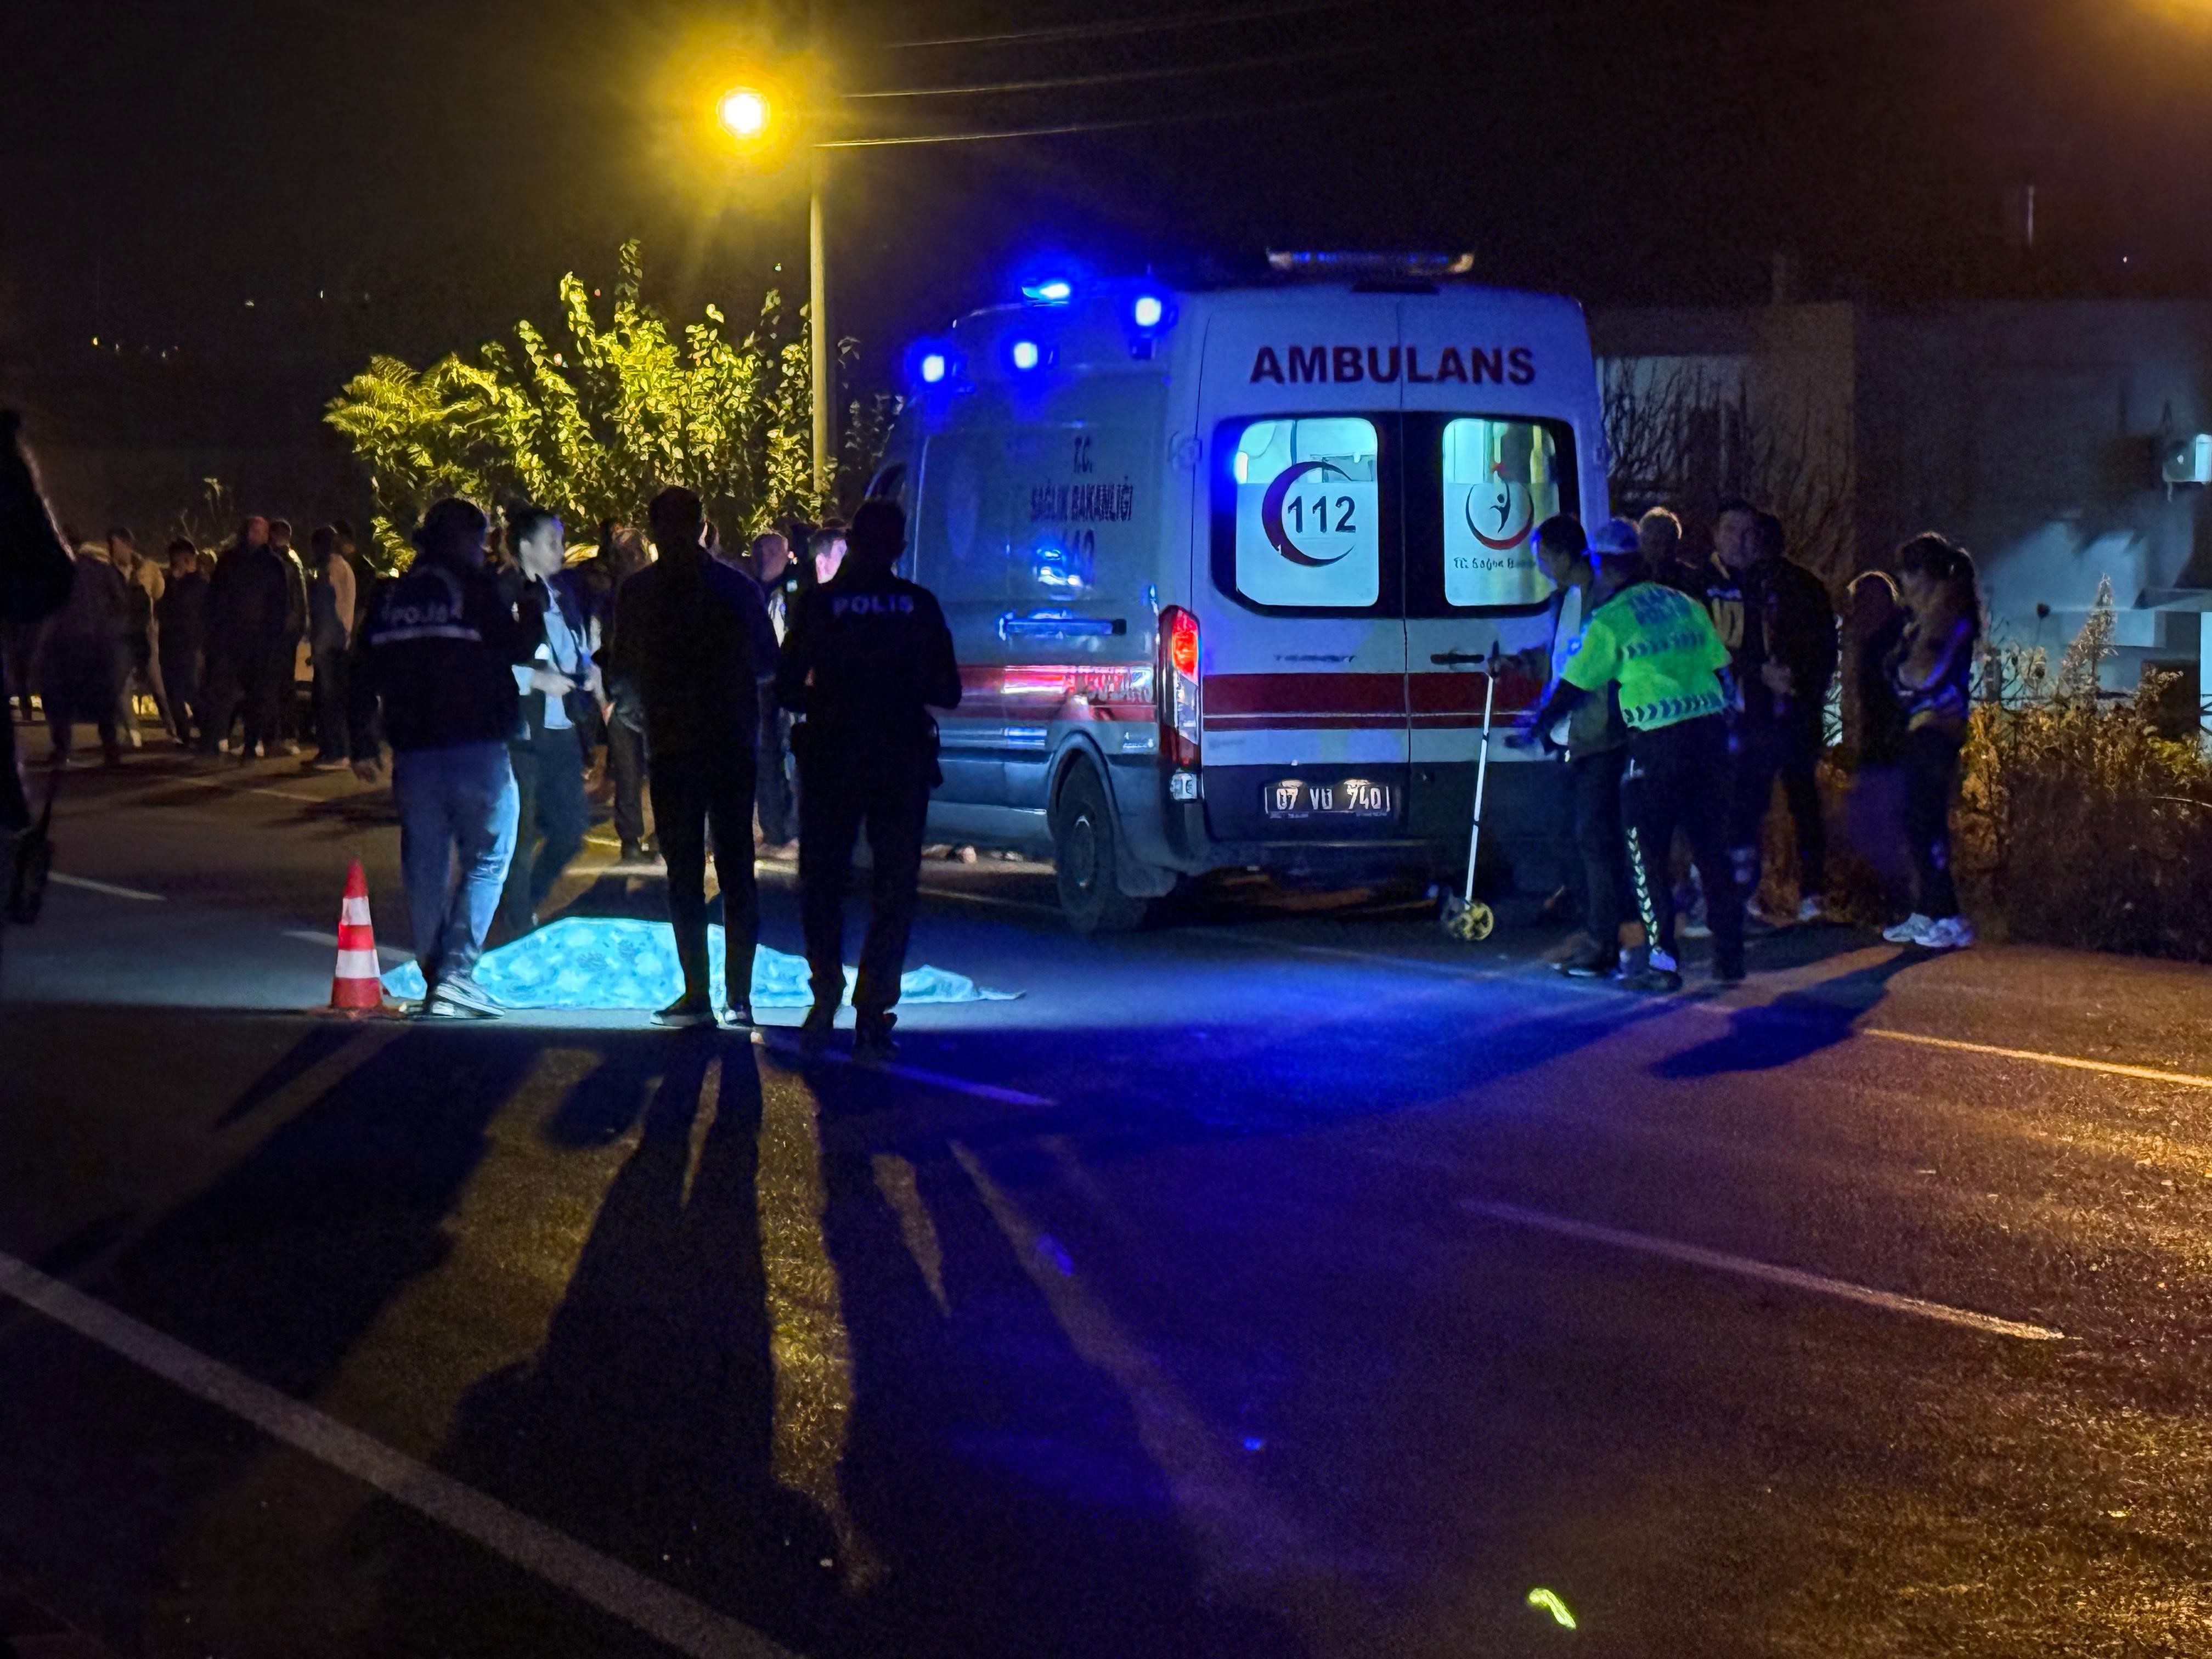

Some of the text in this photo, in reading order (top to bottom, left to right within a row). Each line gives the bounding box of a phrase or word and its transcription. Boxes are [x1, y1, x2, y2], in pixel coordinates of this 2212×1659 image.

[1250, 345, 1536, 385] AMBULANS
[1288, 495, 1356, 533] 112
[1276, 788, 1299, 810] 07
[1347, 785, 1381, 810] 740
